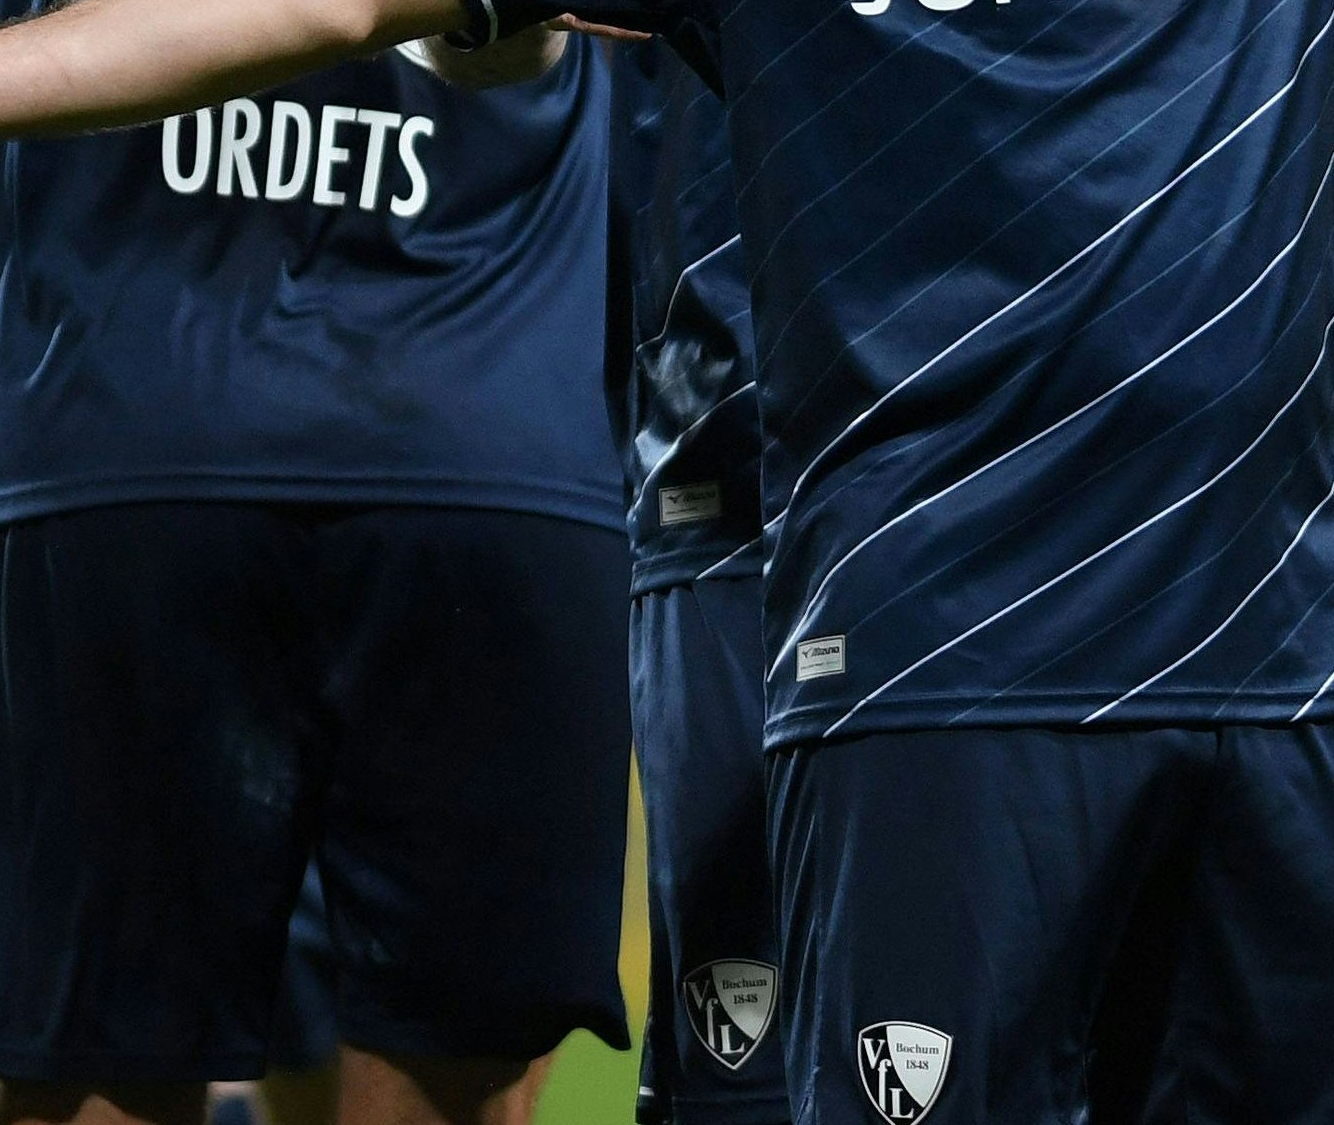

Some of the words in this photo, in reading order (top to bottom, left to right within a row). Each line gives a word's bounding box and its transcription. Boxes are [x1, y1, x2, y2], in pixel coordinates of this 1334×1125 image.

[722, 978, 768, 989] Bochum
[896, 1042, 940, 1055] Bochum
[906, 1059, 929, 1070] 1848
